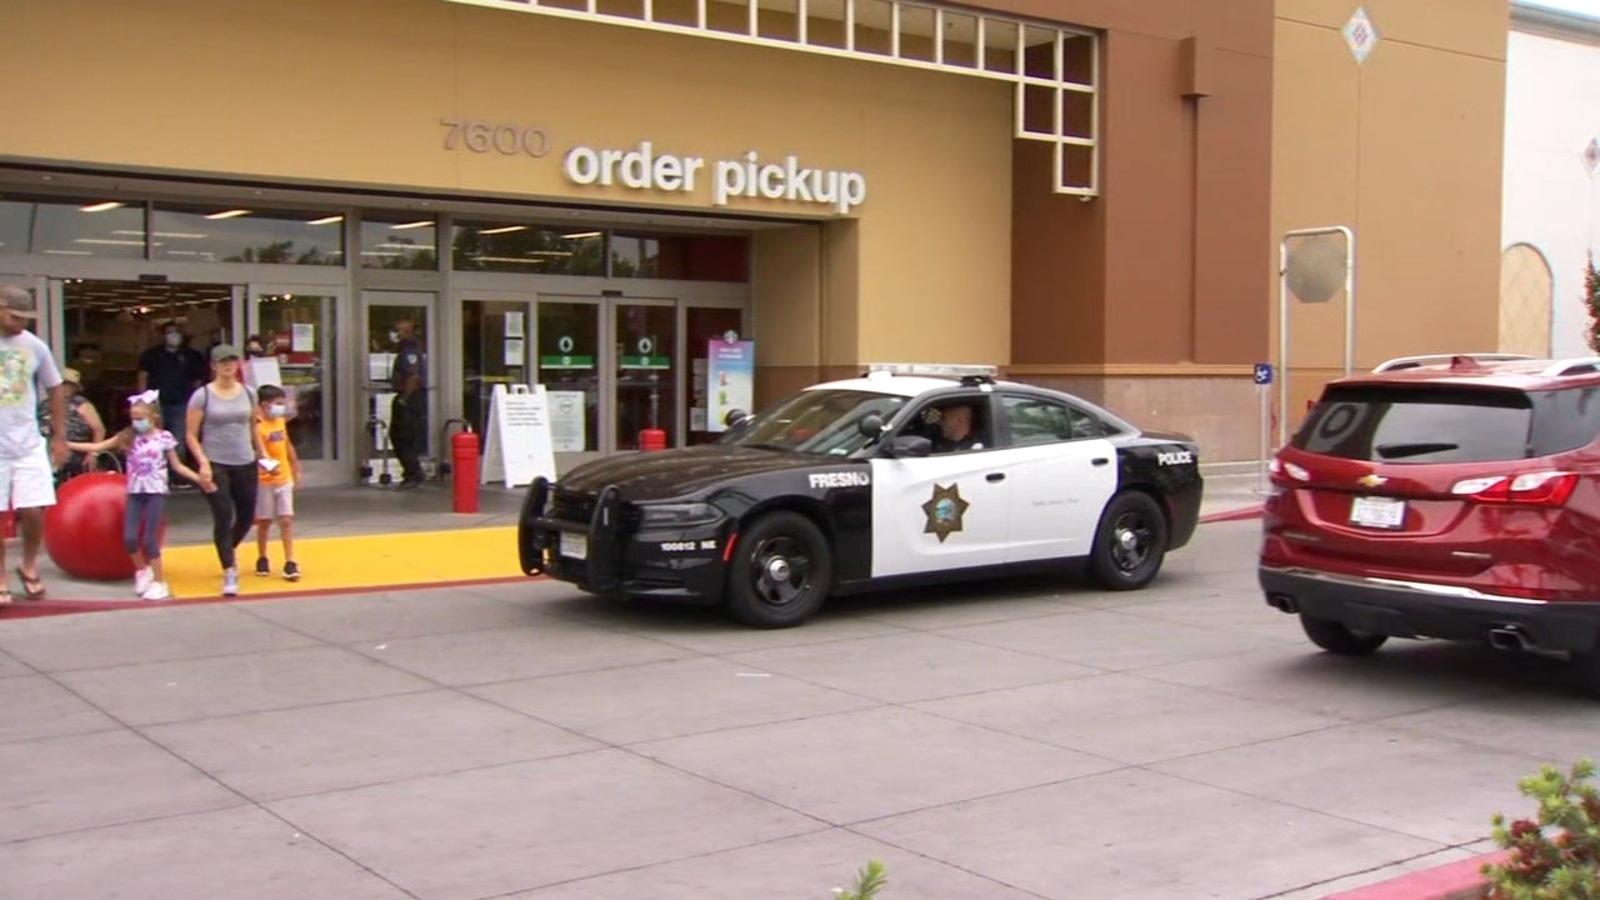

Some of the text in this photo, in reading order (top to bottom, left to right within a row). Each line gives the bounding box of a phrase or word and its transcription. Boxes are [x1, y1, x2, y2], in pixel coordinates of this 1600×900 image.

[440, 118, 551, 158] 7600
[565, 141, 866, 214] order pickup
[1157, 451, 1193, 466] POLICE
[808, 471, 870, 489] FRESNO
[700, 539, 717, 550] NE
